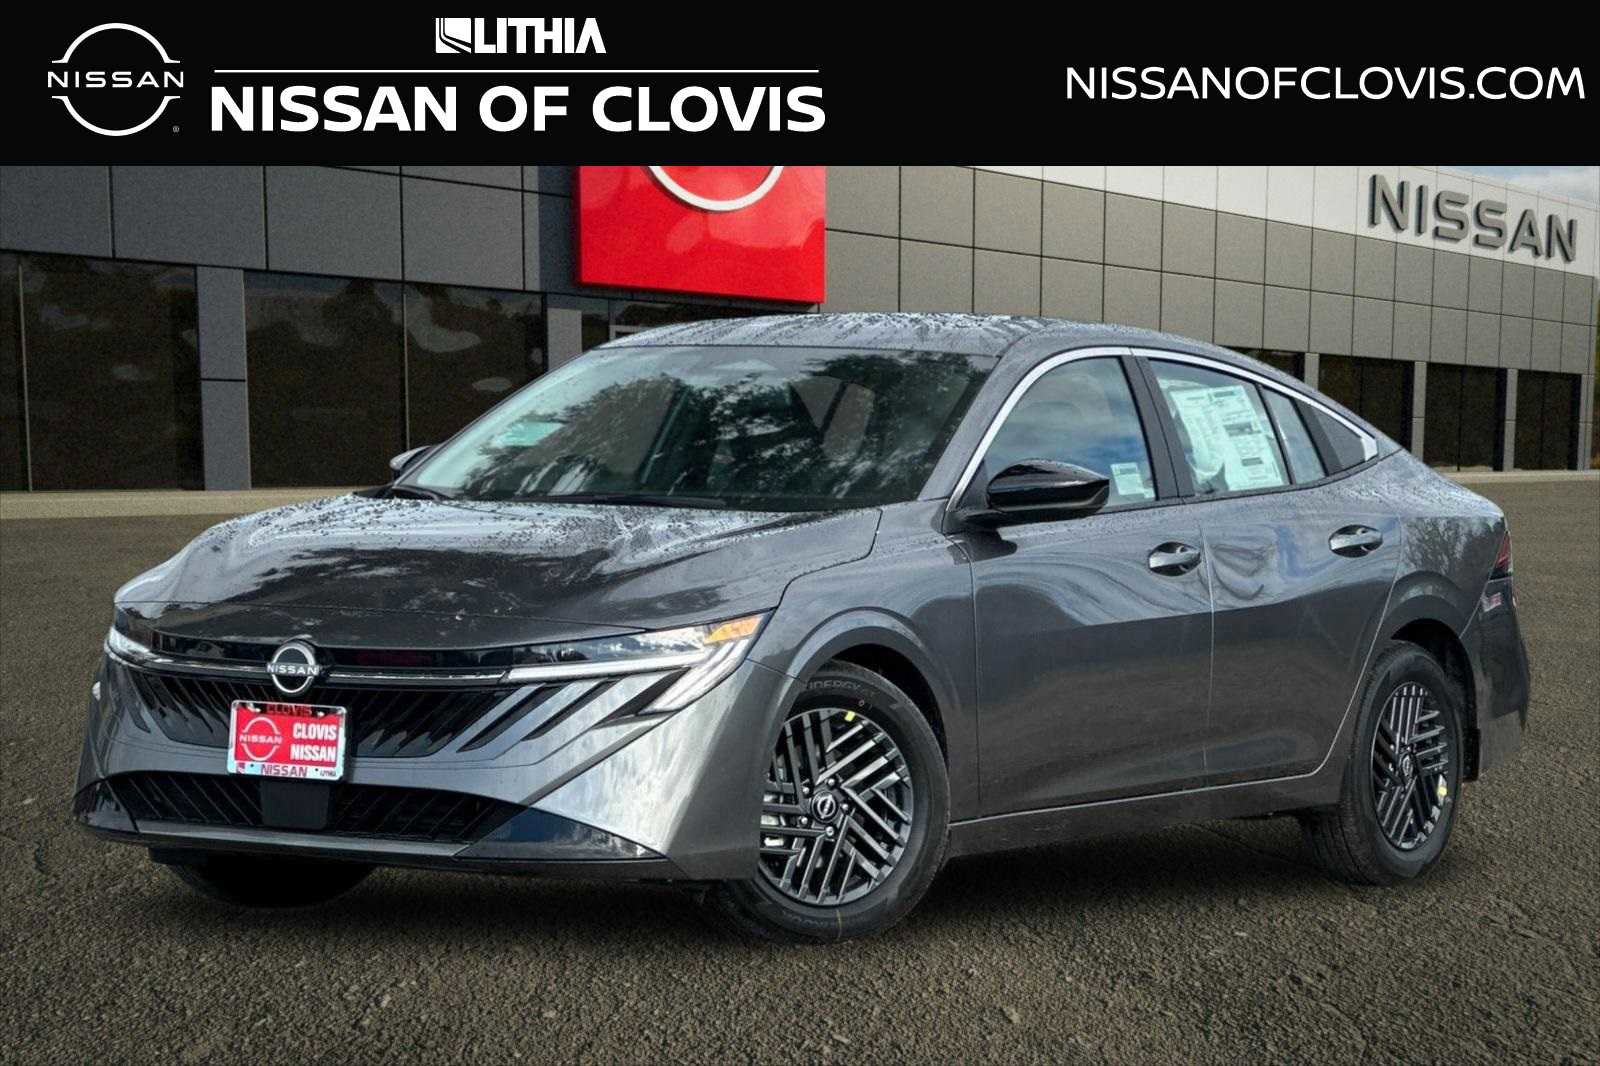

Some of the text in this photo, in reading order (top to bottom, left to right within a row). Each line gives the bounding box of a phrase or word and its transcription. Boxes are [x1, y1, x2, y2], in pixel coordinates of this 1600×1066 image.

[1368, 174, 1577, 264] NISSAN
[267, 664, 319, 676] NISSAN
[293, 722, 337, 740] CLOVIS
[239, 734, 283, 744] NISSAN
[290, 744, 337, 762] NISSAN
[261, 764, 309, 777] NISSAN
